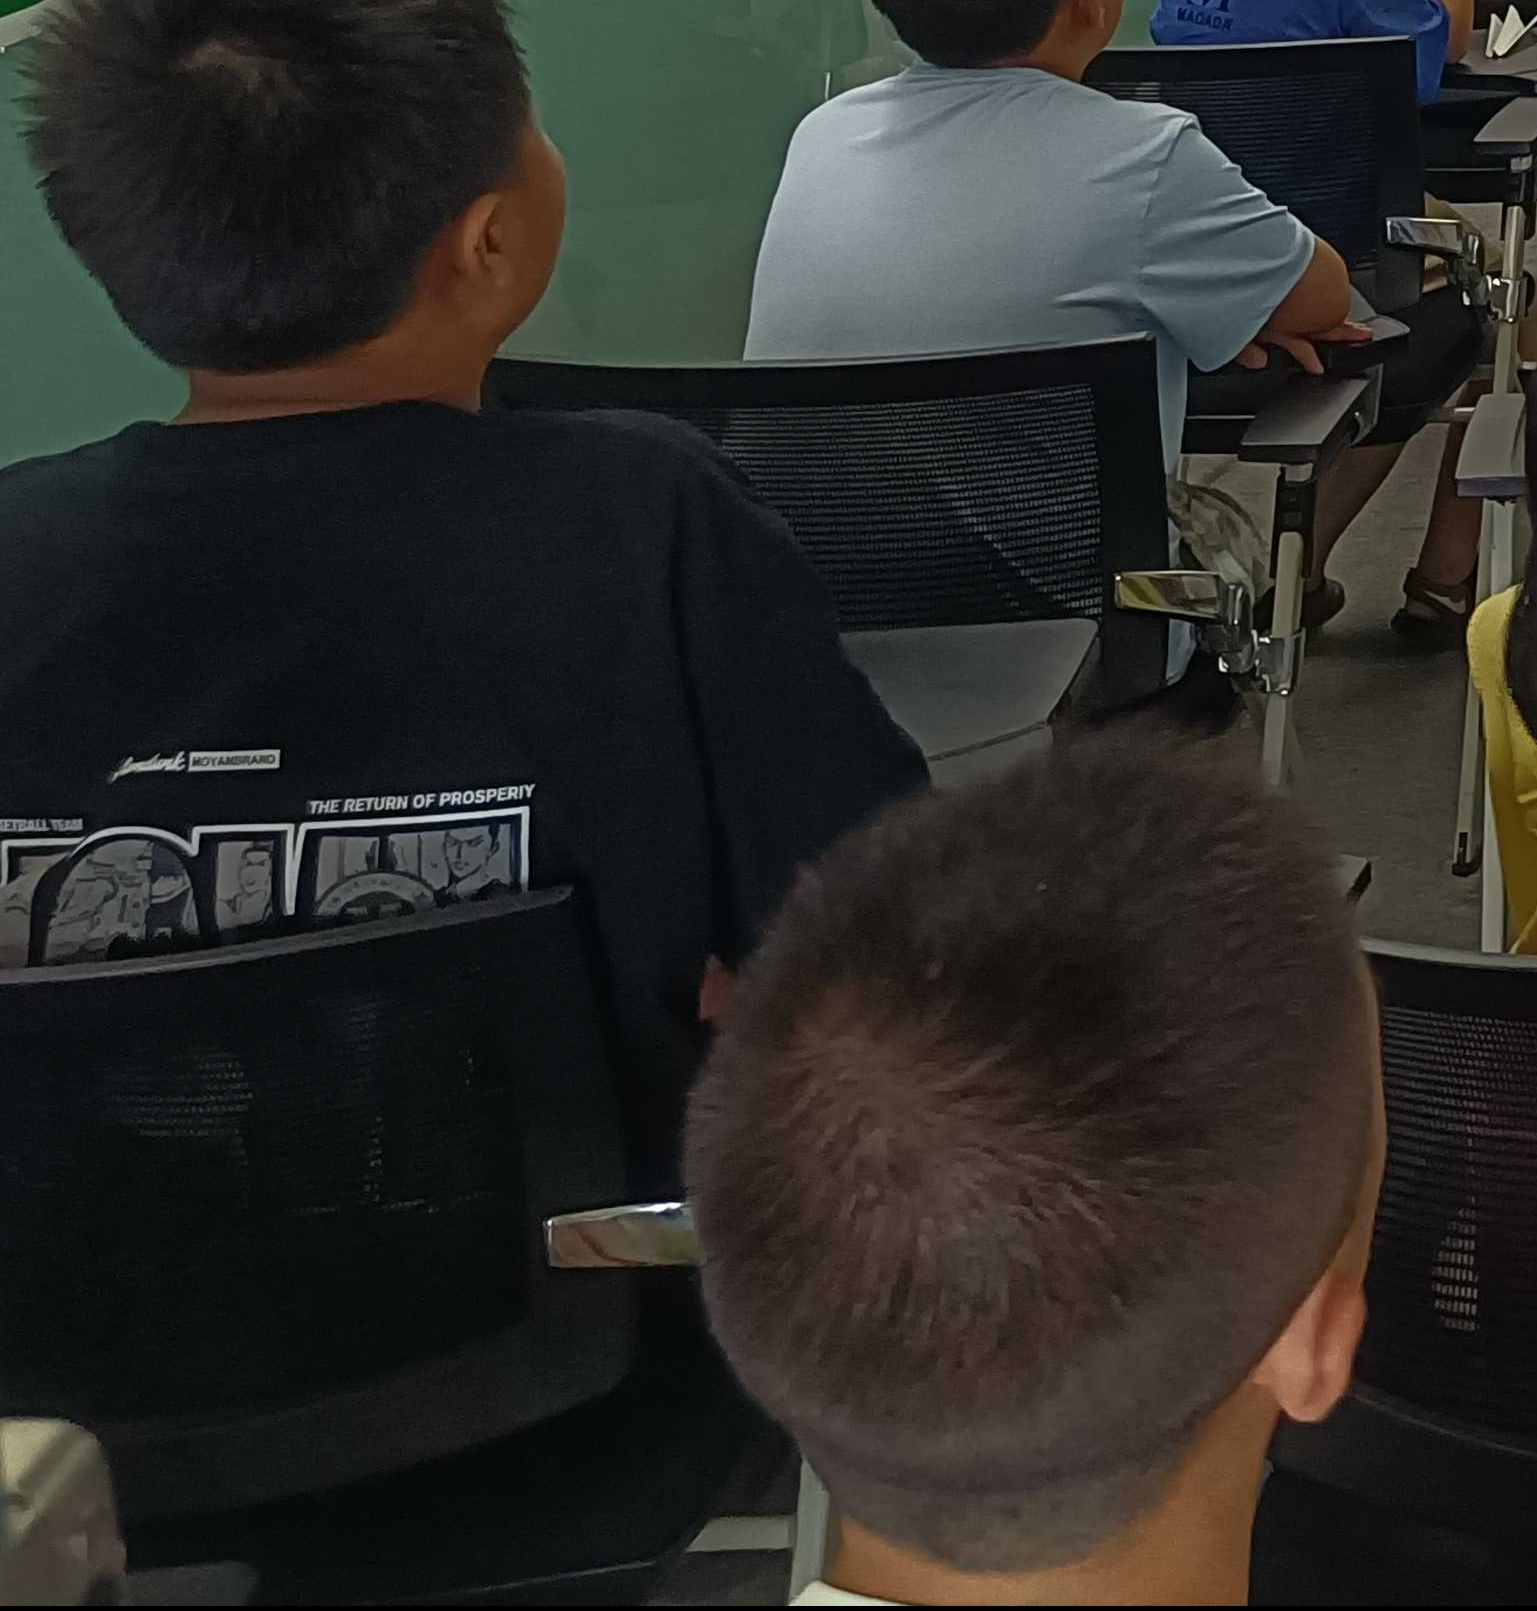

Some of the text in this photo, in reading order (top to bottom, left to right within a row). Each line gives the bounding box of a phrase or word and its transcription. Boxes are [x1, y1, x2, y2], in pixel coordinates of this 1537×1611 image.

[309, 800, 340, 814] THE
[342, 796, 408, 813] RETURN
[412, 793, 436, 808] OF
